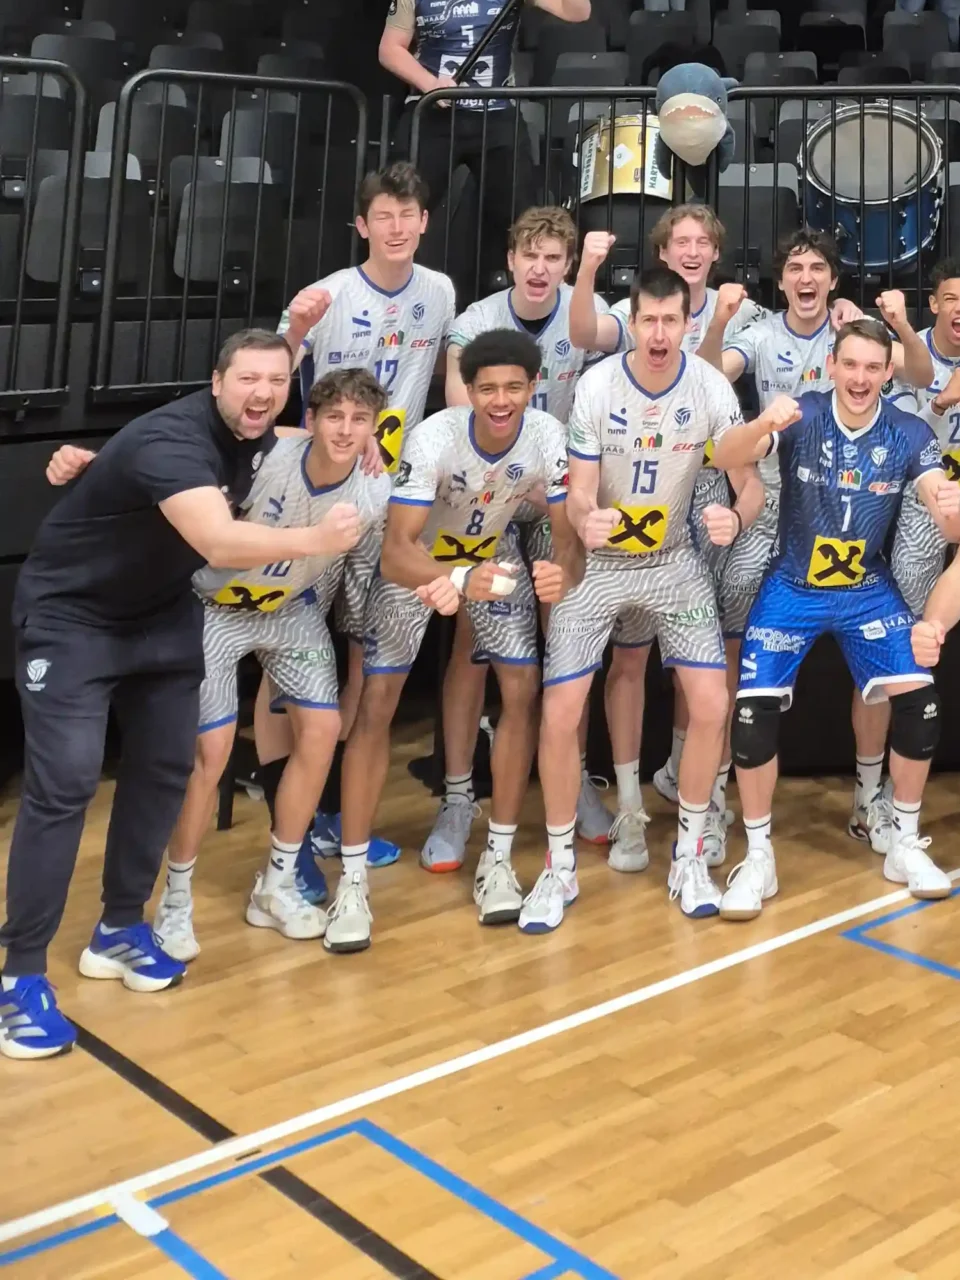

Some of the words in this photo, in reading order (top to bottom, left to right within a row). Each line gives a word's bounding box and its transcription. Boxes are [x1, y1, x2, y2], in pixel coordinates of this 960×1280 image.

[461, 24, 474, 48] 5
[351, 329, 371, 339] nine
[342, 350, 370, 360] HAAS
[375, 359, 399, 396] 12
[607, 428, 627, 436] nine
[631, 460, 659, 495] 15
[465, 509, 485, 536] 8
[884, 615, 916, 629] HAA
[741, 671, 757, 681] nine
